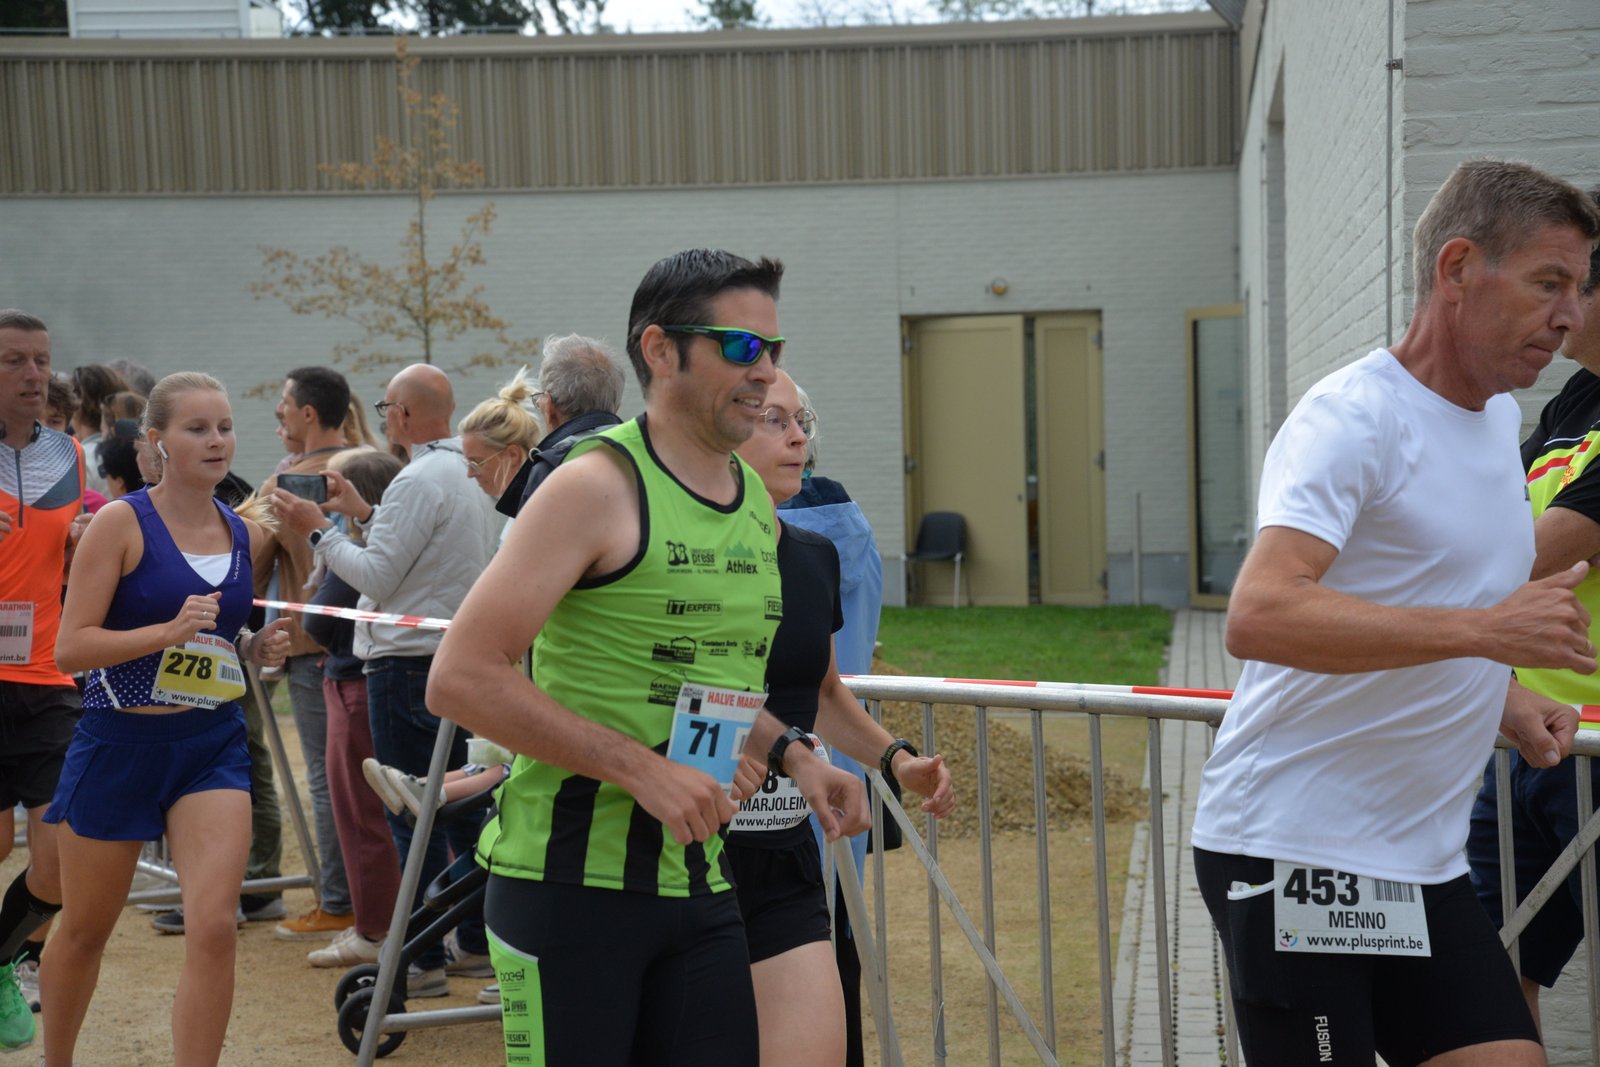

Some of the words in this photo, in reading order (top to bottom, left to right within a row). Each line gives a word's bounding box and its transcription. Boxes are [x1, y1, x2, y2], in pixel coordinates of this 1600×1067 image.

[726, 560, 758, 574] Athlex
[0, 603, 32, 611] ARATHON
[686, 603, 721, 613] EXPERTS
[164, 652, 213, 680] 278
[171, 693, 223, 707] www.plusp
[707, 691, 736, 707] HALVE
[688, 720, 721, 758] 71
[739, 796, 807, 812] MARJOLEIN
[1283, 868, 1360, 907] 453
[1328, 911, 1386, 930] MENNO
[1306, 934, 1424, 951] www.plusprint.be
[1314, 1015, 1333, 1063] FUSION
